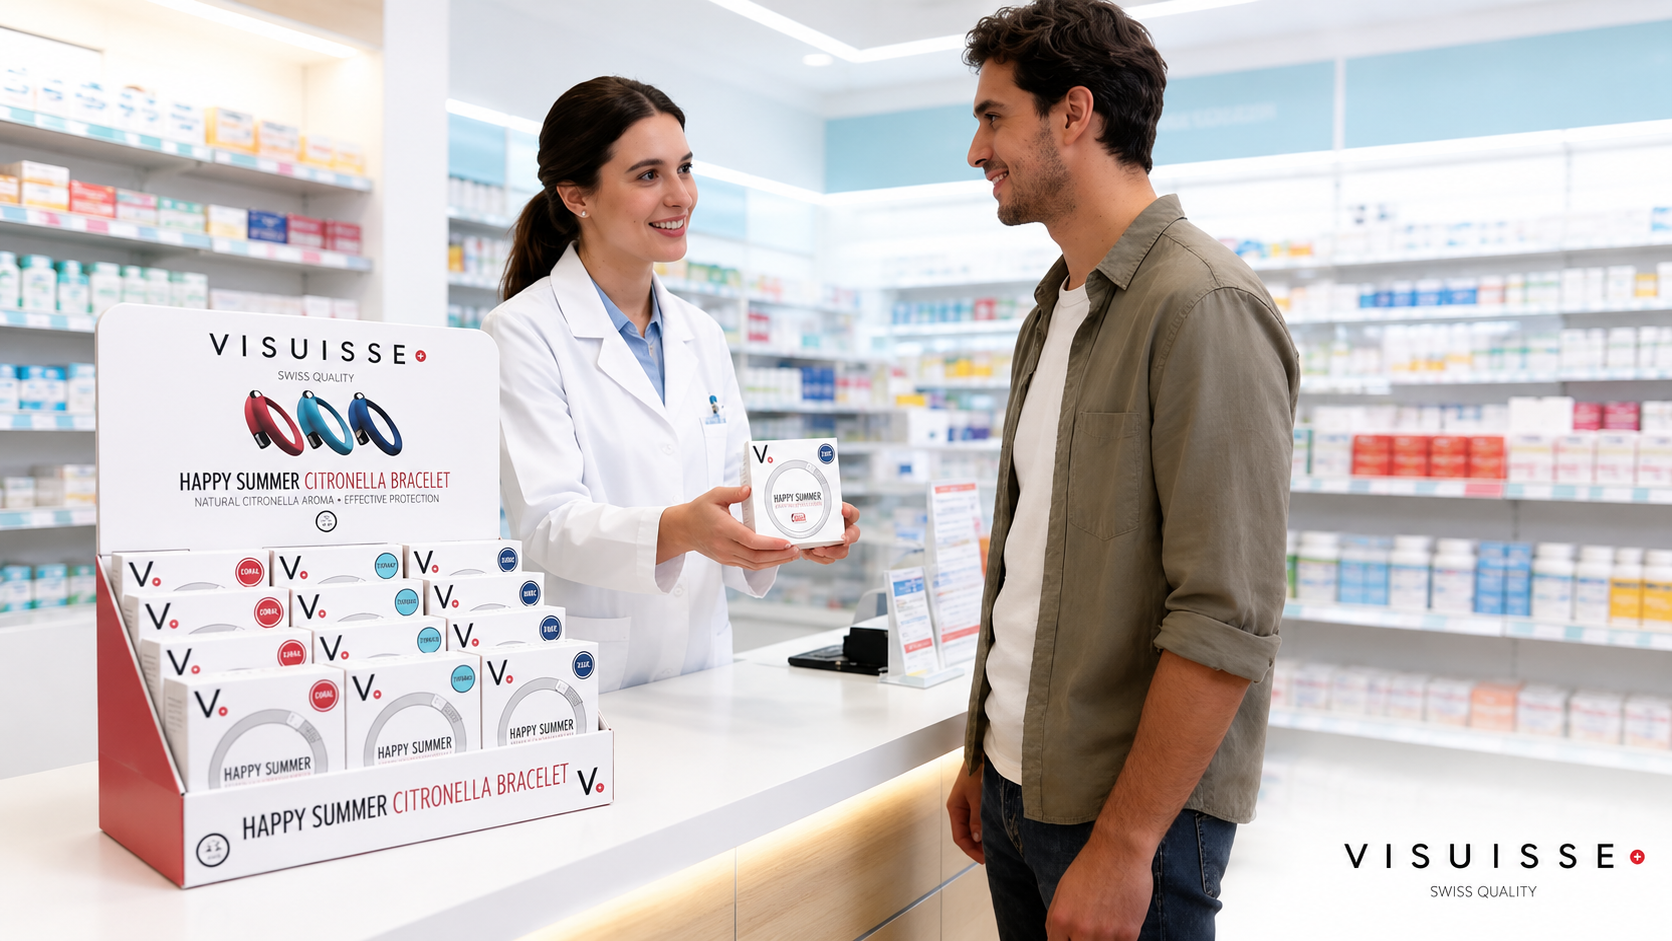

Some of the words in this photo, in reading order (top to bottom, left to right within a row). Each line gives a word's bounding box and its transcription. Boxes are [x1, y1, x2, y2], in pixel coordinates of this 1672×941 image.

[209, 333, 406, 364] VISUISSE
[278, 370, 310, 382] SWISS
[312, 372, 354, 382] QUALITY
[752, 444, 768, 464] V
[180, 472, 232, 490] HAPPY
[236, 472, 300, 490] SUMMER
[304, 472, 386, 490] CITRONELLA
[391, 472, 450, 488] BRACELET
[194, 496, 240, 507] NATURAL
[242, 496, 300, 506] CITRONELLA
[302, 496, 334, 505] AROMA
[344, 494, 388, 504] EFFECTIVE
[390, 494, 440, 504] PROTECTION
[774, 493, 794, 502] HAPPY
[795, 492, 822, 501] SUMMER
[128, 561, 154, 587] V
[279, 556, 302, 580] V
[414, 550, 434, 574] V
[297, 594, 320, 620] V
[434, 585, 454, 608] V
[145, 602, 171, 630] V
[320, 634, 342, 661] V
[453, 623, 474, 648] V
[166, 648, 192, 676] V
[487, 660, 508, 686] V
[352, 674, 375, 701] V
[194, 688, 220, 718] V
[510, 724, 536, 740] HAPPY
[540, 718, 574, 734] SUMMER
[378, 742, 408, 760] HAPPY
[412, 736, 452, 754] SUMMER
[224, 763, 262, 782] HAPPY
[266, 756, 311, 776] SUMMER
[576, 766, 598, 796] V
[243, 808, 306, 840] HAPPY
[312, 794, 388, 828] SUMMER
[393, 776, 492, 814] CITRONELLA
[497, 762, 569, 796] BRACELET
